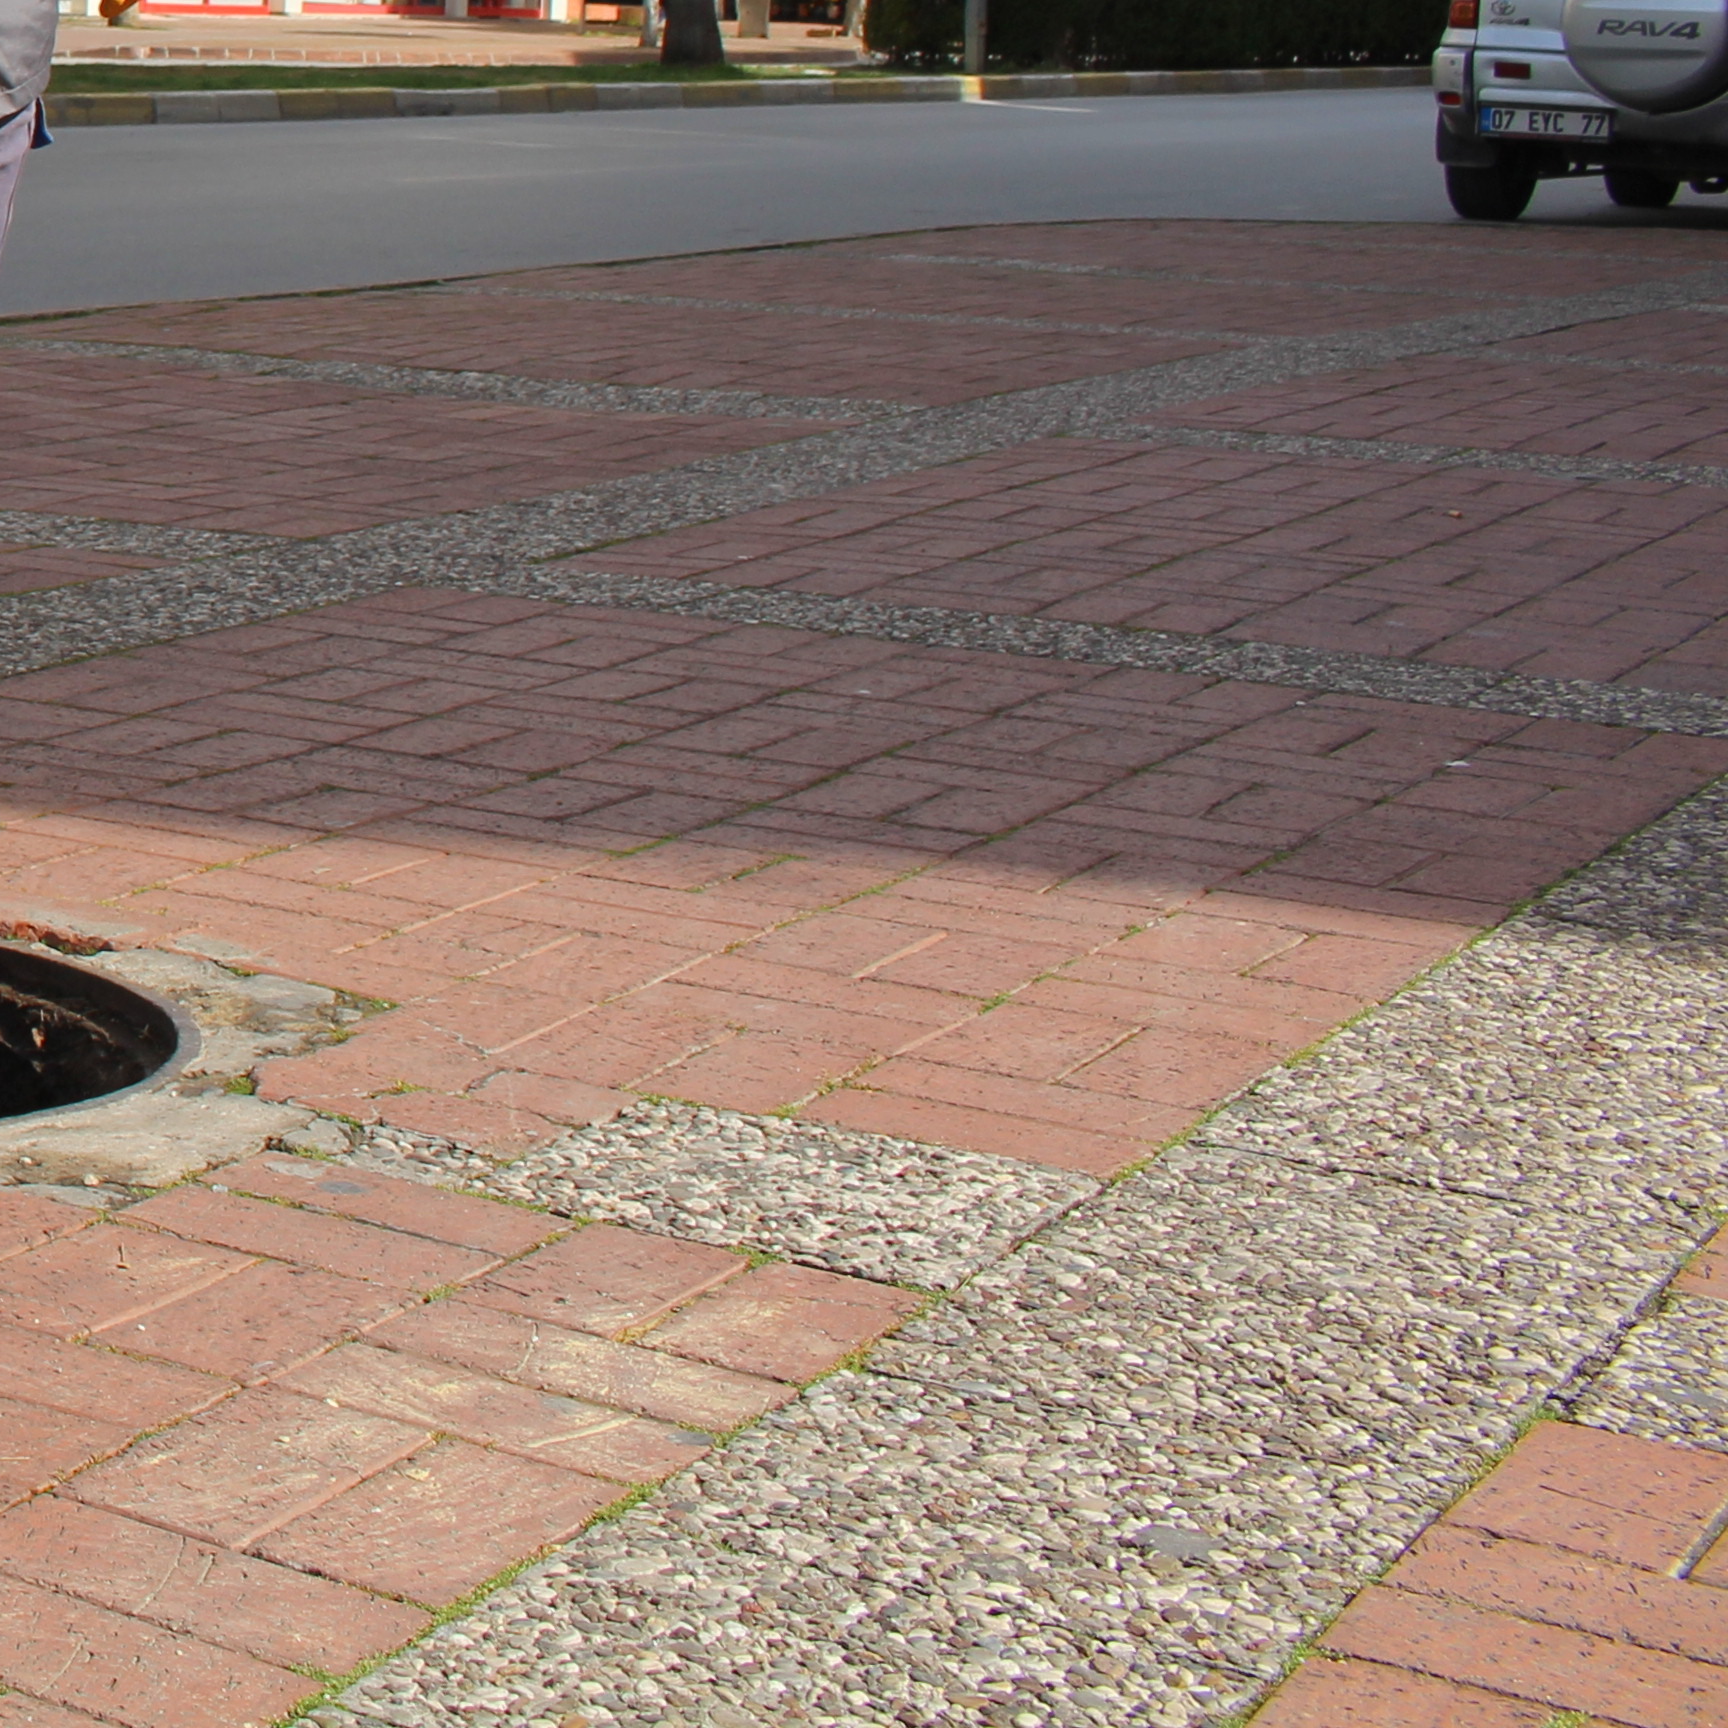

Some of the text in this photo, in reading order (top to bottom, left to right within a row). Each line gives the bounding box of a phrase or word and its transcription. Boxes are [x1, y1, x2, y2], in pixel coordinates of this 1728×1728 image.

[1597, 18, 1701, 40] RAV4
[1491, 109, 1607, 135] 07 EYC 77
